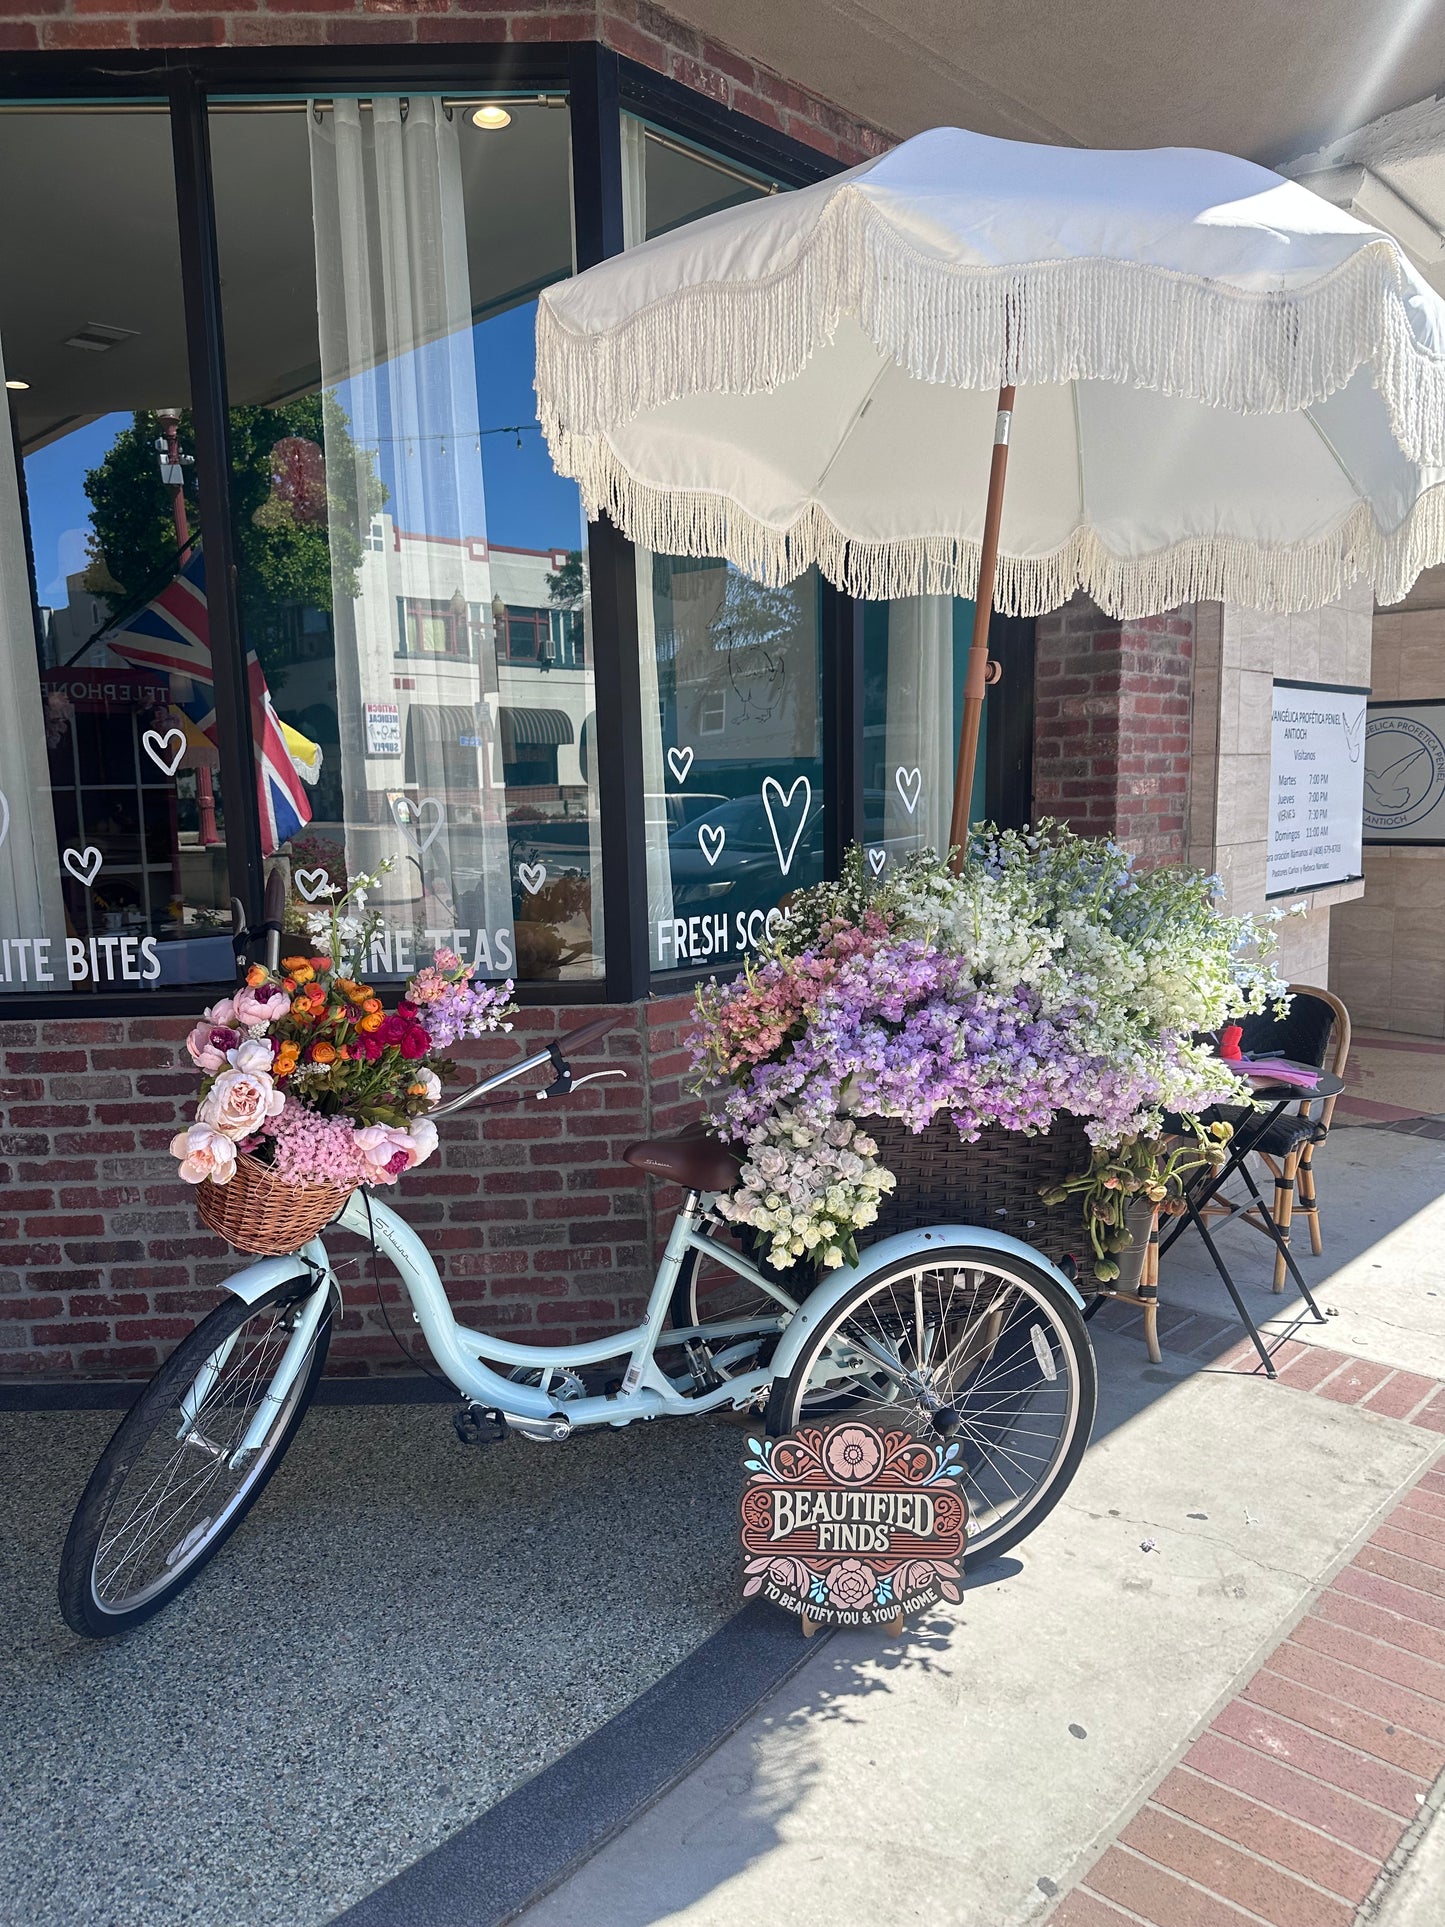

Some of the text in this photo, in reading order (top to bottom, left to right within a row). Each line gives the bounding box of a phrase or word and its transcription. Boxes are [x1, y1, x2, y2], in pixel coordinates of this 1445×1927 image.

[1283, 728, 1307, 740] ANTIOCH
[1397, 721, 1438, 751] PROFETICA
[1435, 751, 1445, 783] PENIEL
[1278, 774, 1329, 786] Martes 7:00 PM
[1277, 794, 1295, 805] Jueves
[1320, 791, 1328, 802] PM
[1320, 808, 1328, 819] PM
[1364, 815, 1407, 825] ANTIOCH
[1274, 831, 1300, 842] Domingos
[1320, 826, 1328, 836] AM
[424, 928, 513, 972] TEAS
[657, 913, 728, 961] FRESH
[0, 936, 161, 982] ITE BITES
[770, 1490, 934, 1541] BEAUTIFIED
[817, 1523, 890, 1551] FINDS
[764, 1581, 780, 1600] TO
[779, 1592, 834, 1623] BEAUTIFY
[836, 1611, 859, 1625] YOU
[862, 1611, 872, 1624] &
[902, 1587, 938, 1615] HOME
